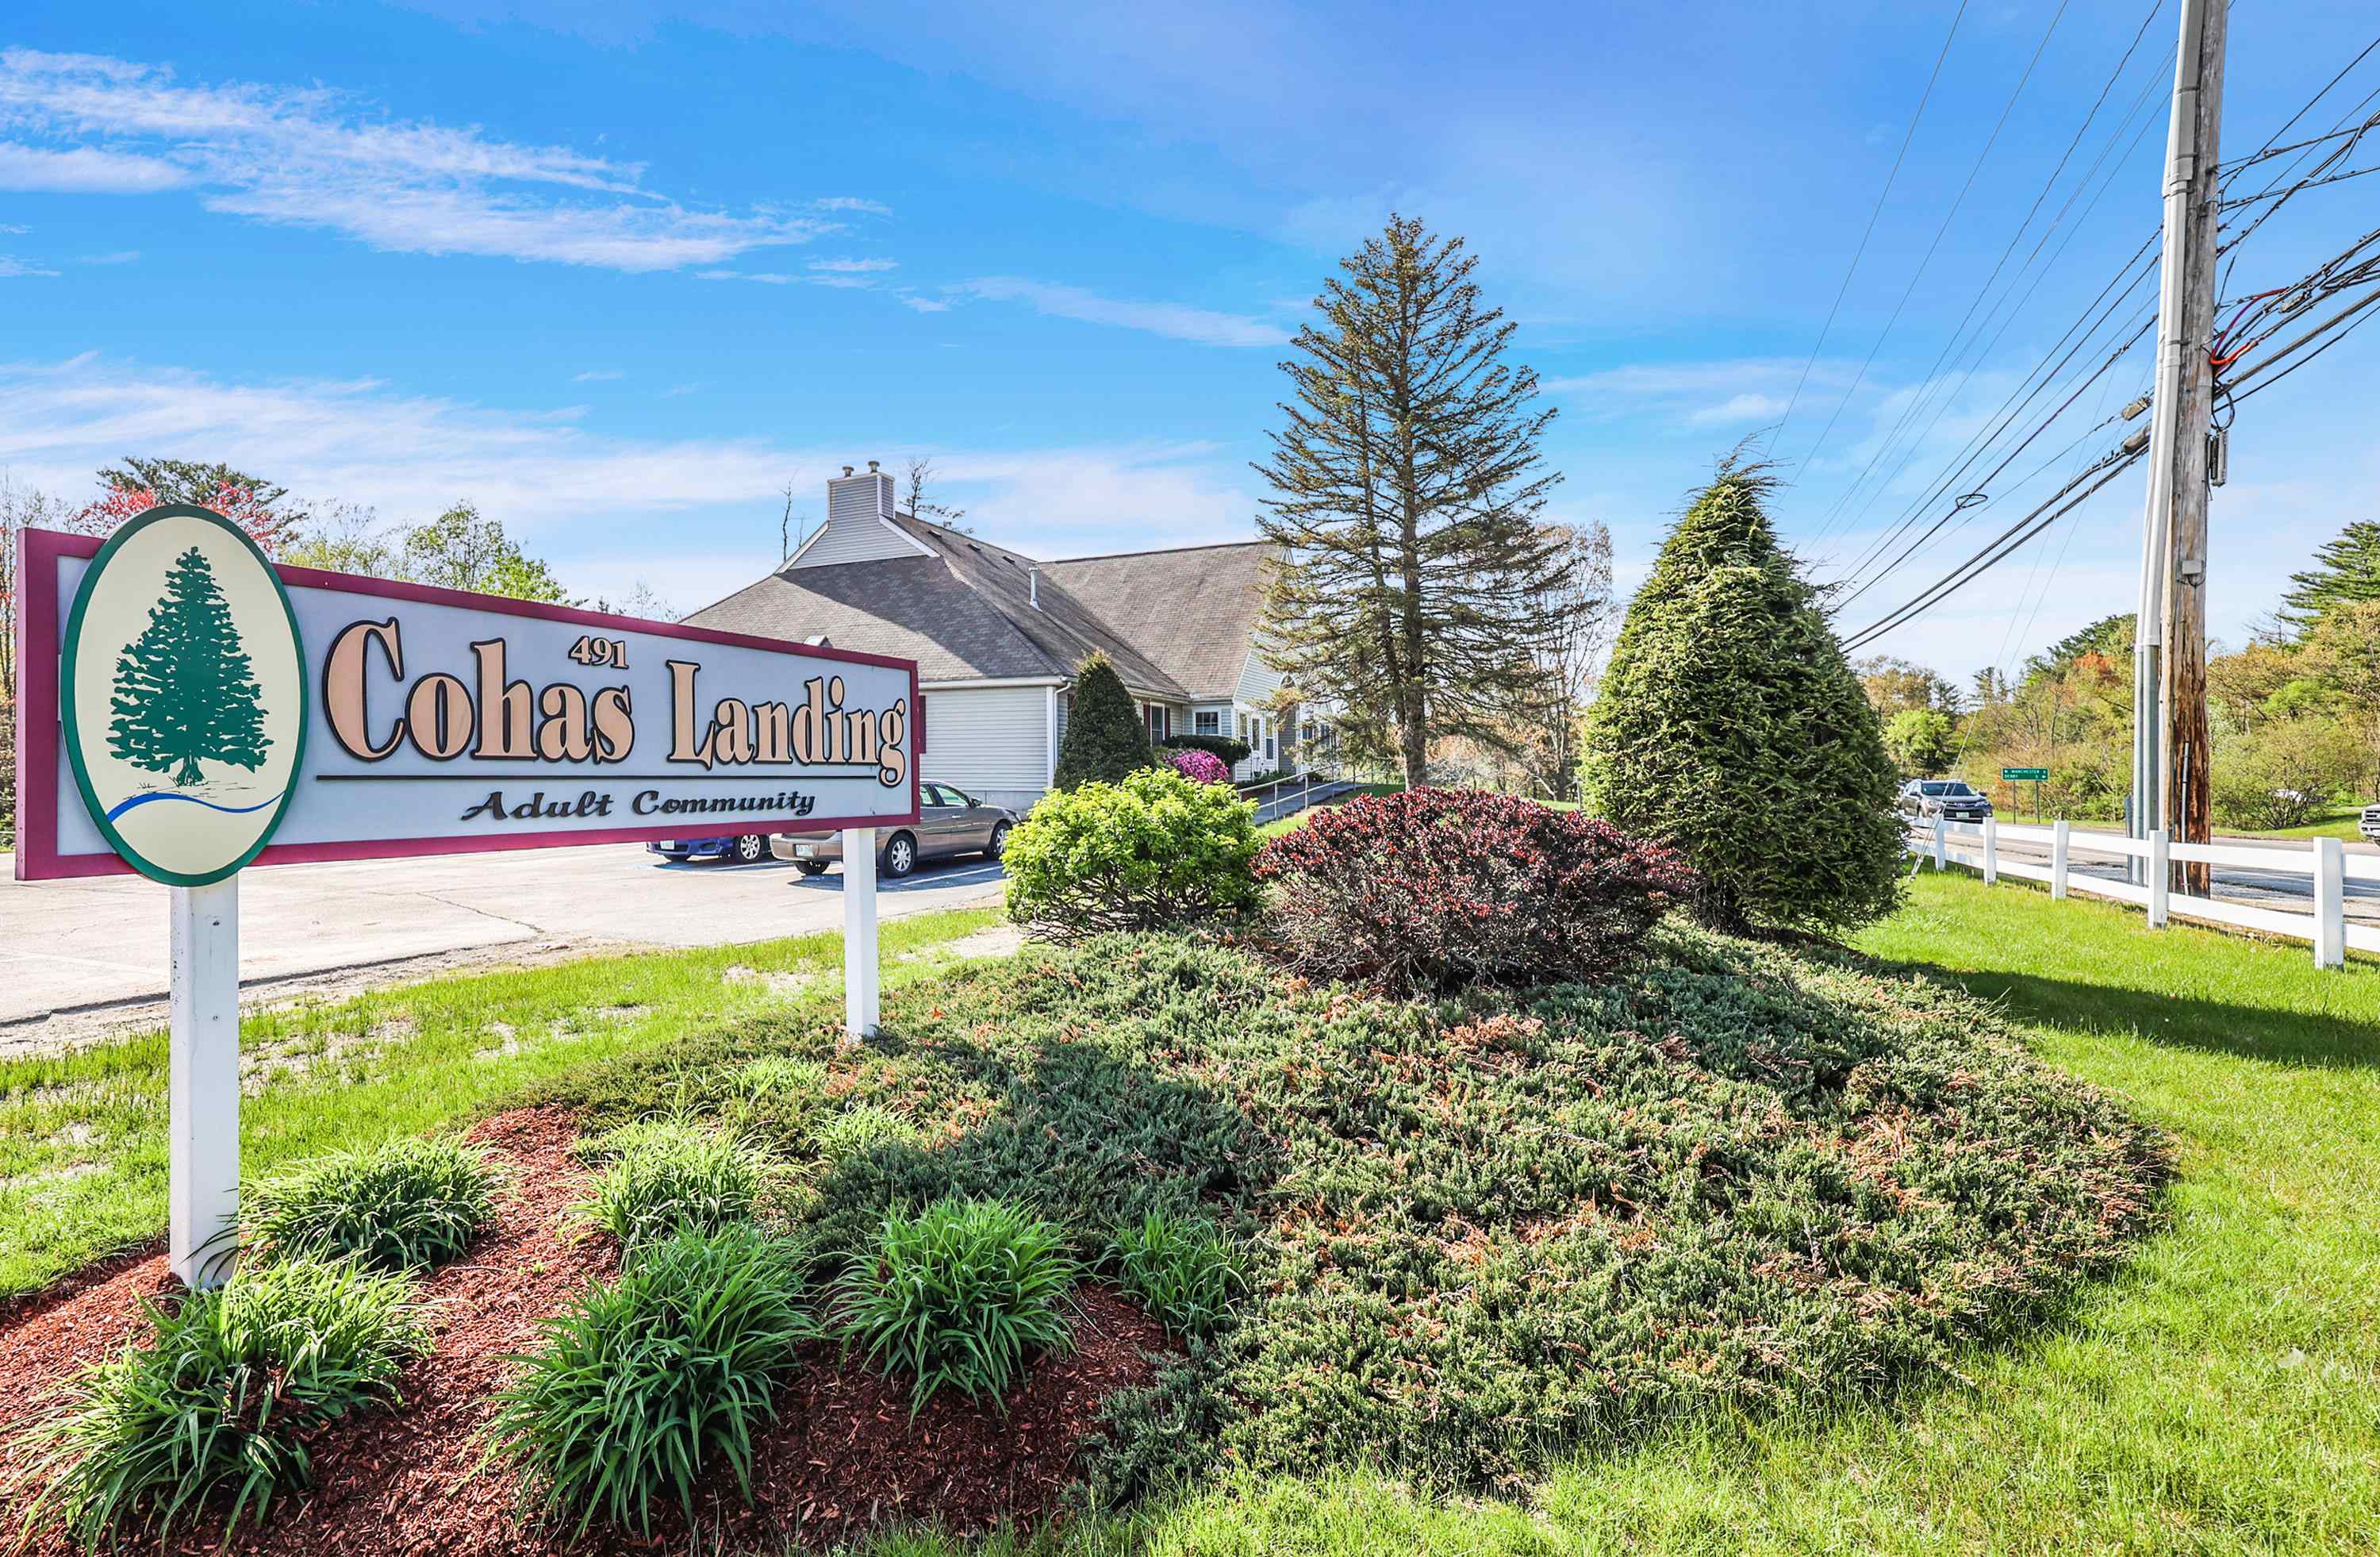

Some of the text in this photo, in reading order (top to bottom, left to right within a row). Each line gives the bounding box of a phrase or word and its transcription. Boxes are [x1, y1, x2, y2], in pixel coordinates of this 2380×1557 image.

[568, 634, 630, 670] 491
[321, 616, 908, 788] Cohas Landing
[461, 790, 816, 821] Adult Community
